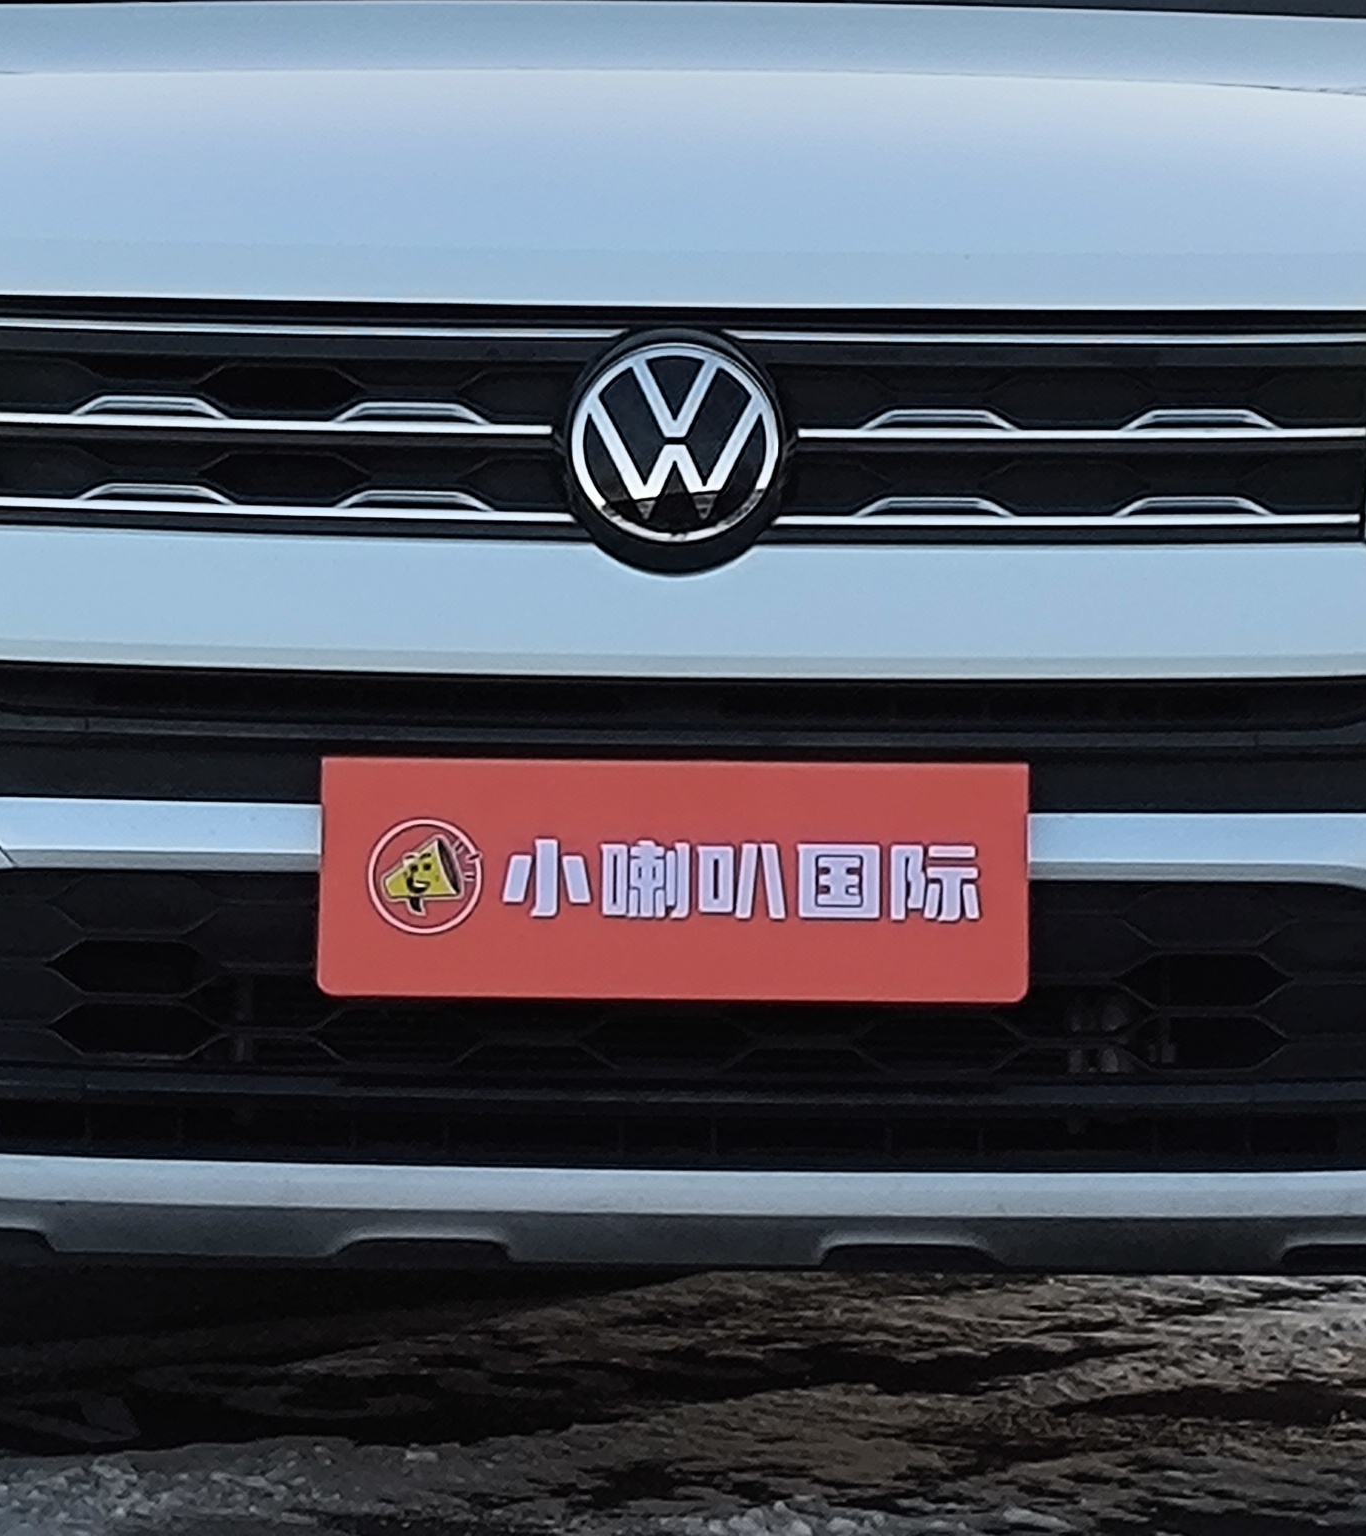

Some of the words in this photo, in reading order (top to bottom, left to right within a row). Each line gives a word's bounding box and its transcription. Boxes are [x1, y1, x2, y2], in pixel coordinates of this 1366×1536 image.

[502, 838, 984, 922] 小喇叭国际
